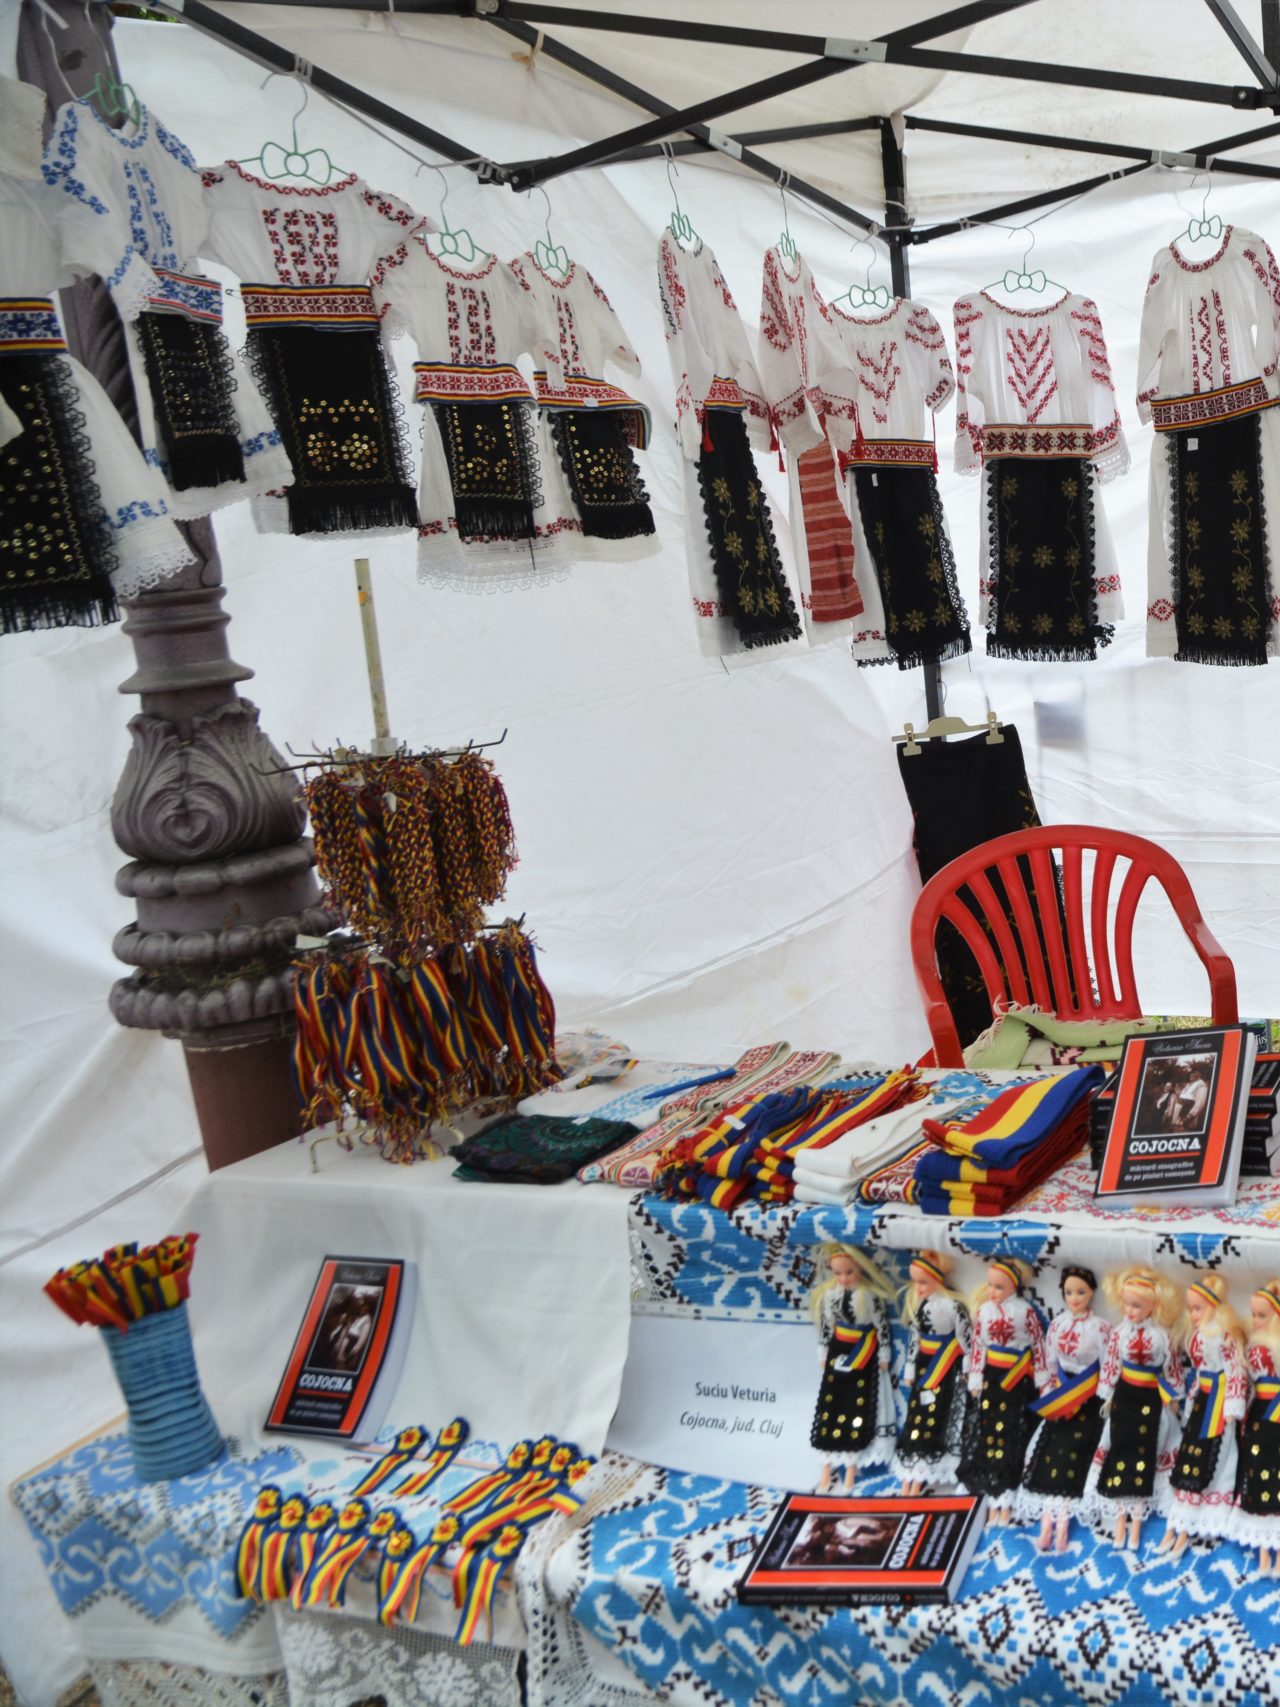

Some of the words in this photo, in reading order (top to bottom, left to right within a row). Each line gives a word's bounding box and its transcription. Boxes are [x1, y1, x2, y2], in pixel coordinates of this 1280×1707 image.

[1129, 1137, 1201, 1154] COJOCNA
[300, 1373, 353, 1392] COJOCNA
[695, 1381, 728, 1398] Suciu
[730, 1385, 777, 1403] Veturia
[679, 1411, 730, 1432] Cojocna,
[729, 1416, 755, 1434] jud.
[759, 1418, 784, 1439] Cluj
[888, 1513, 925, 1568] COJOCNA
